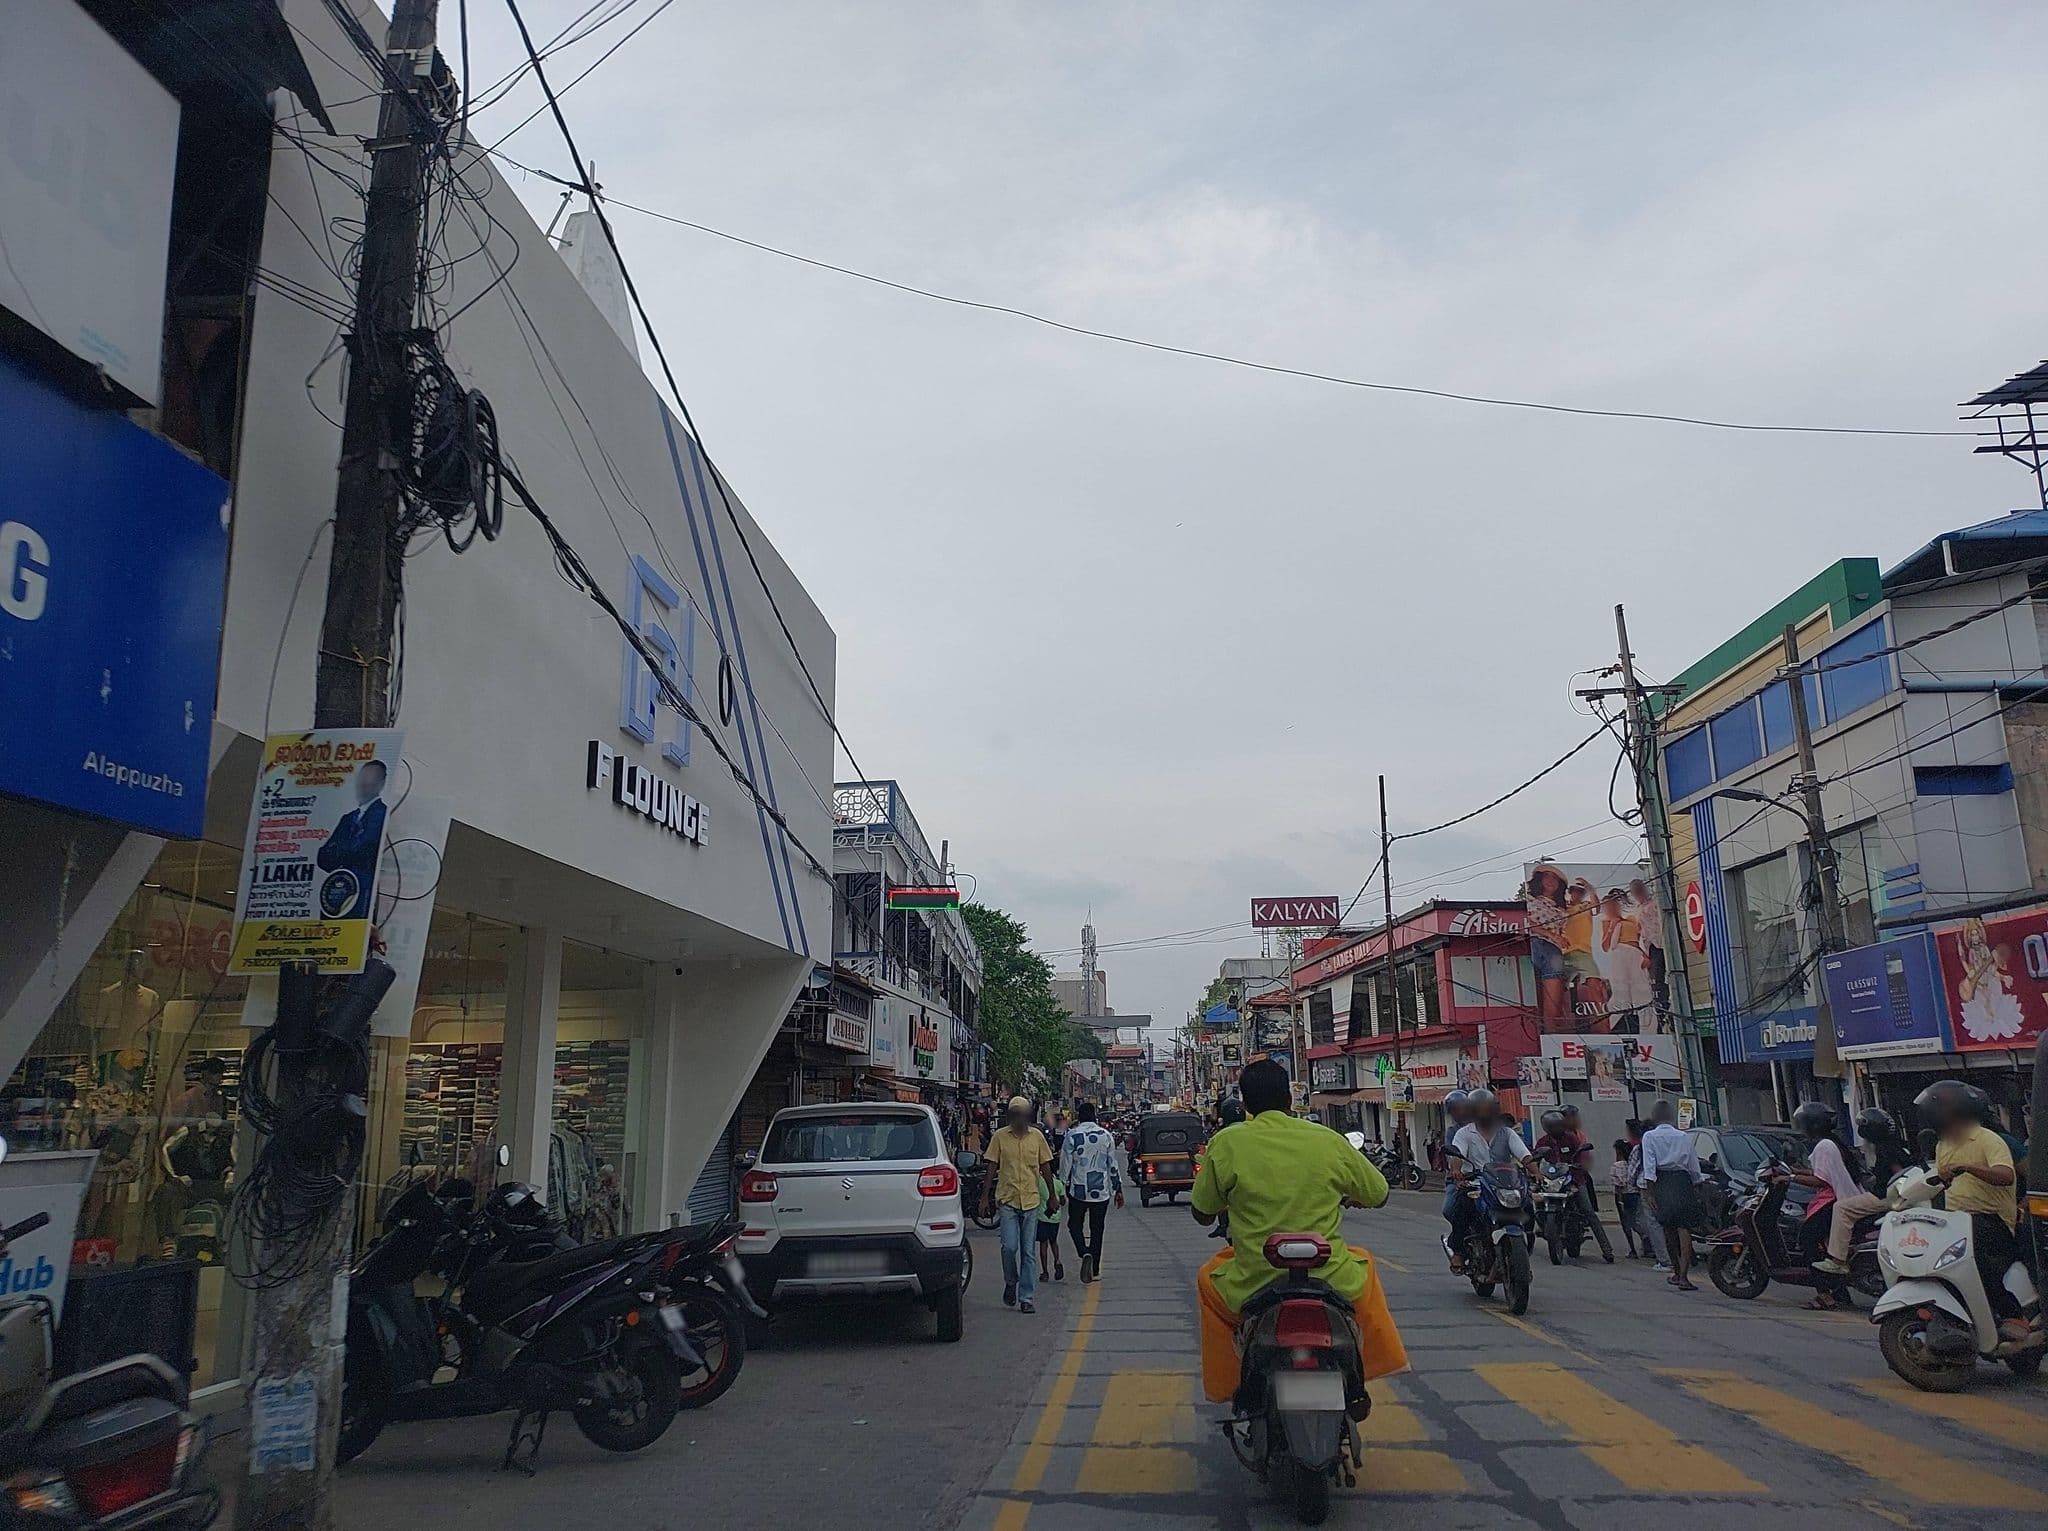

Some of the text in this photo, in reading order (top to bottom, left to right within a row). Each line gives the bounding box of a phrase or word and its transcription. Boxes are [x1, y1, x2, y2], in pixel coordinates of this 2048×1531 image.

[82, 750, 184, 798] Alappuzha
[587, 740, 711, 846] F LOUNGE
[263, 864, 315, 883] LAKH
[1254, 902, 1338, 922] KALYAN
[1463, 911, 1520, 938] Aisha
[1776, 1019, 1818, 1043] Bomba
